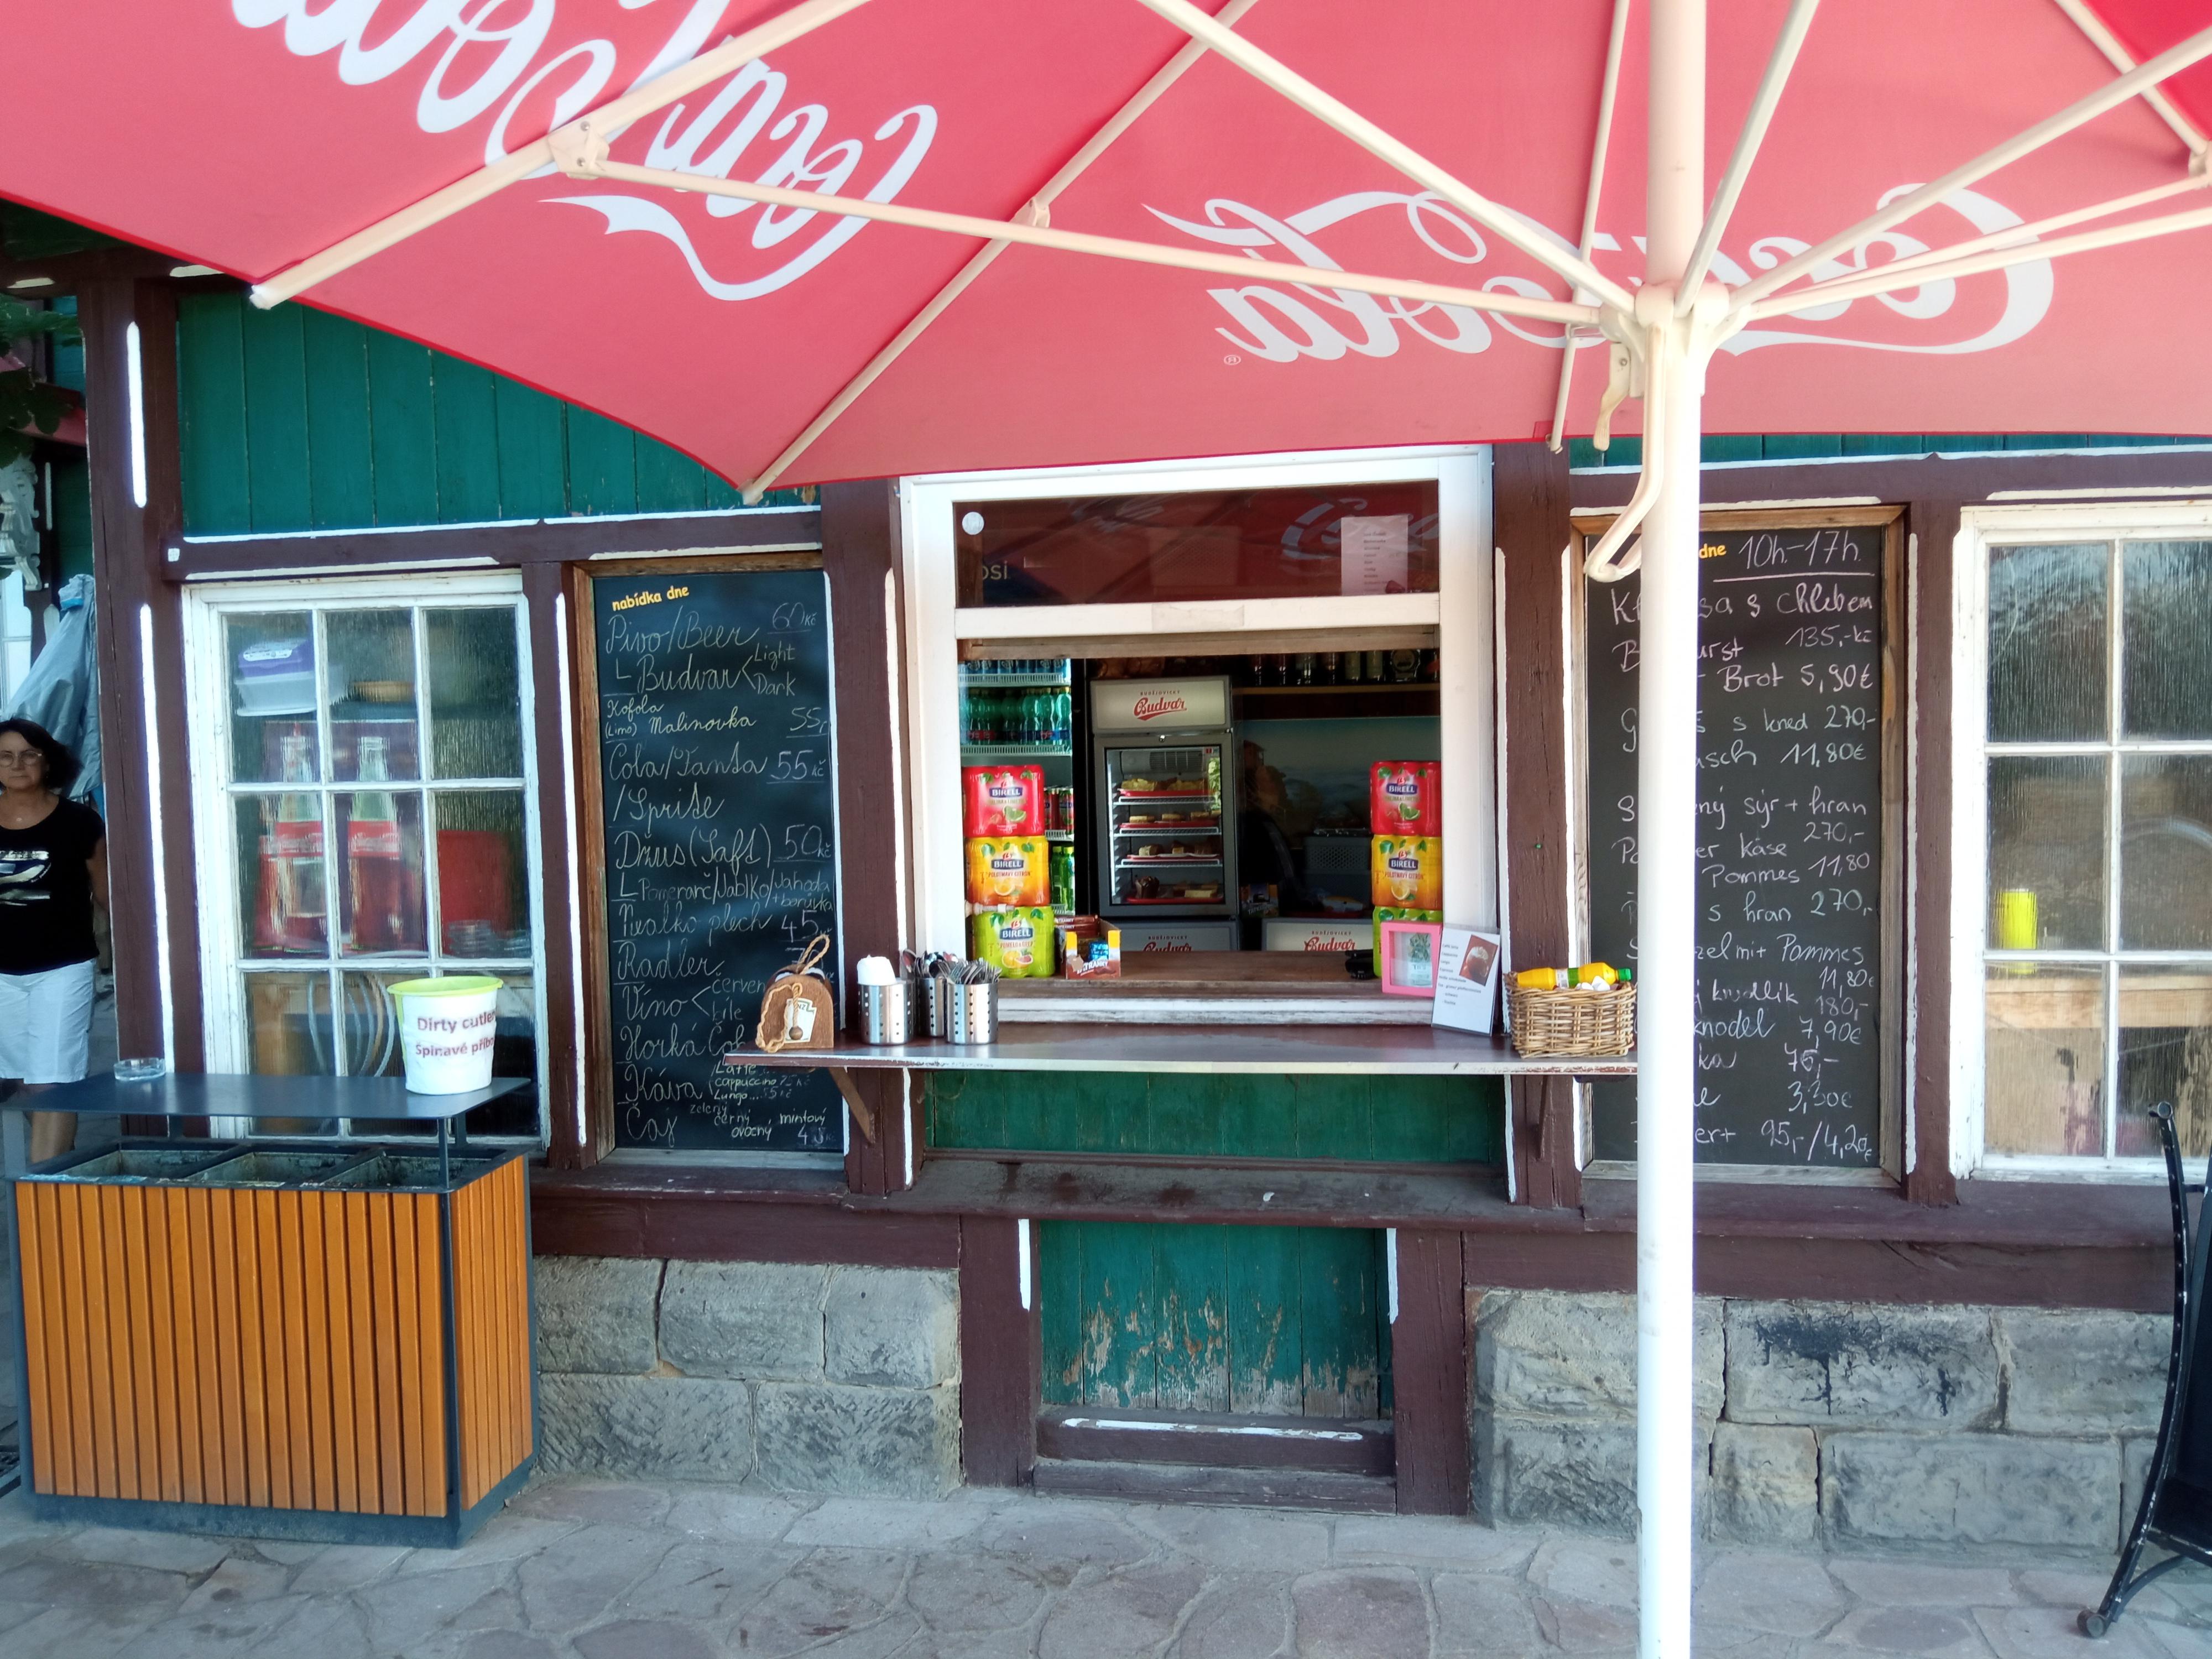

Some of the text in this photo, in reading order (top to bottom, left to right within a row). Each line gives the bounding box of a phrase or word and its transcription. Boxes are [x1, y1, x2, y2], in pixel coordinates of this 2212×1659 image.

[1698, 543, 1726, 559] dne
[612, 585, 690, 611] nabídka dne
[753, 640, 795, 671] Light
[637, 653, 743, 693] Budvar
[754, 671, 797, 696] Dark
[1717, 662, 1785, 692] Brot
[607, 693, 665, 718] Kofola
[1134, 696, 1187, 718] Budvar
[649, 705, 758, 735] Malinovka
[992, 788, 1021, 797] BIRELL
[1389, 785, 1415, 793] BIRELL
[1808, 785, 1867, 816] hran
[994, 860, 1022, 868] BIRELL
[1391, 859, 1416, 869] BIRELL
[1702, 863, 1801, 889] Pommes
[1743, 890, 1792, 923] hran
[1002, 929, 1031, 938] BIRELL
[618, 937, 725, 980] Radler
[1776, 933, 1865, 966] Pommes
[622, 972, 766, 1021] Víno červen
[417, 1009, 497, 1034] Dirty cutler
[471, 1035, 495, 1056] příbo
[620, 1023, 708, 1061] Horká
[624, 1064, 703, 1102] Káva
[731, 1119, 773, 1141] ovocný
